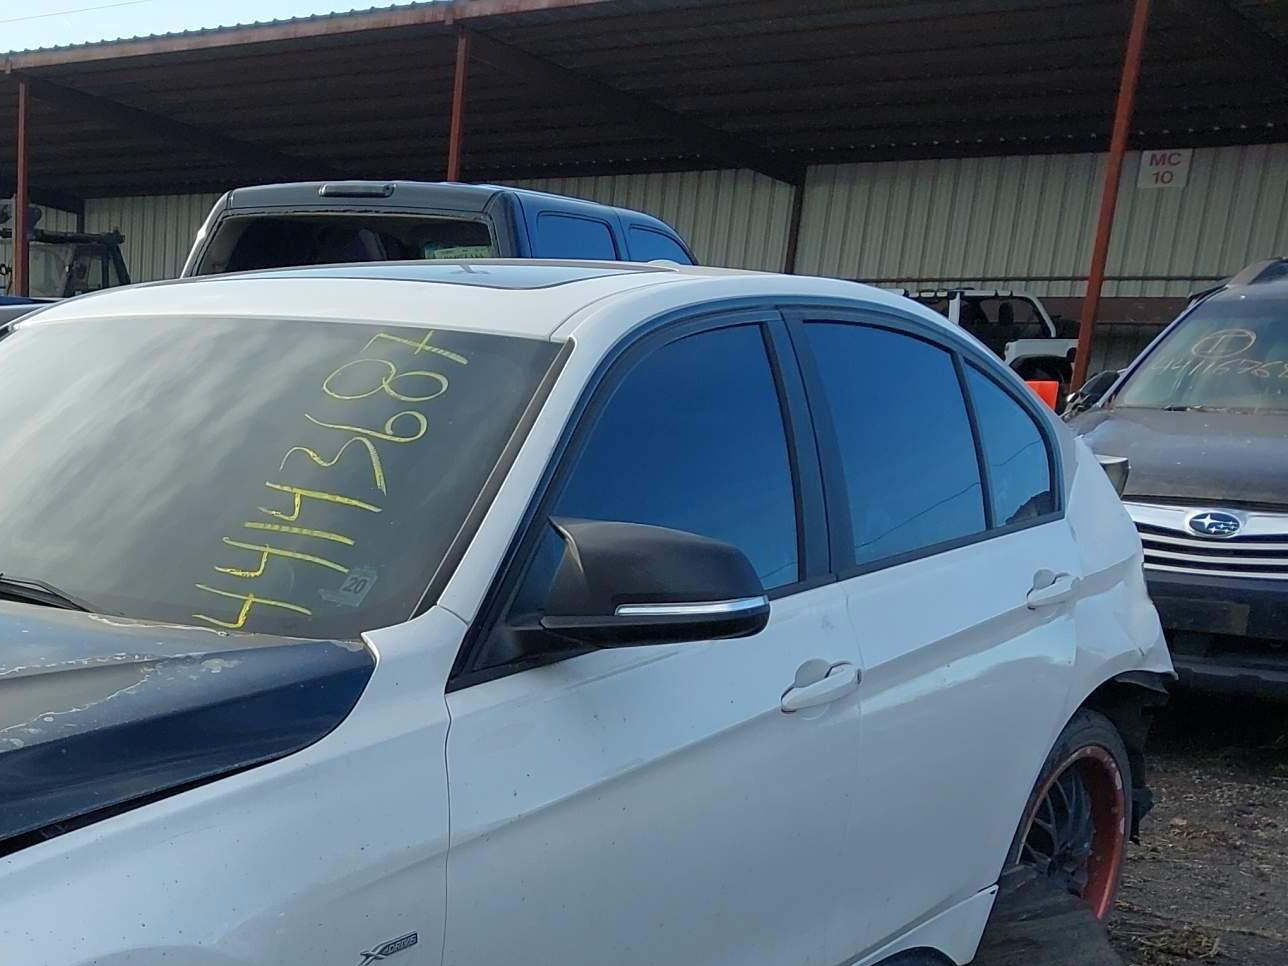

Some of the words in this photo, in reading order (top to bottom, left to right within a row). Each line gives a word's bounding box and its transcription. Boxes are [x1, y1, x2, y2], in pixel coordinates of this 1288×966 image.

[1150, 152, 1182, 167] MC
[1152, 170, 1174, 185] 10
[192, 330, 469, 629] 44143687
